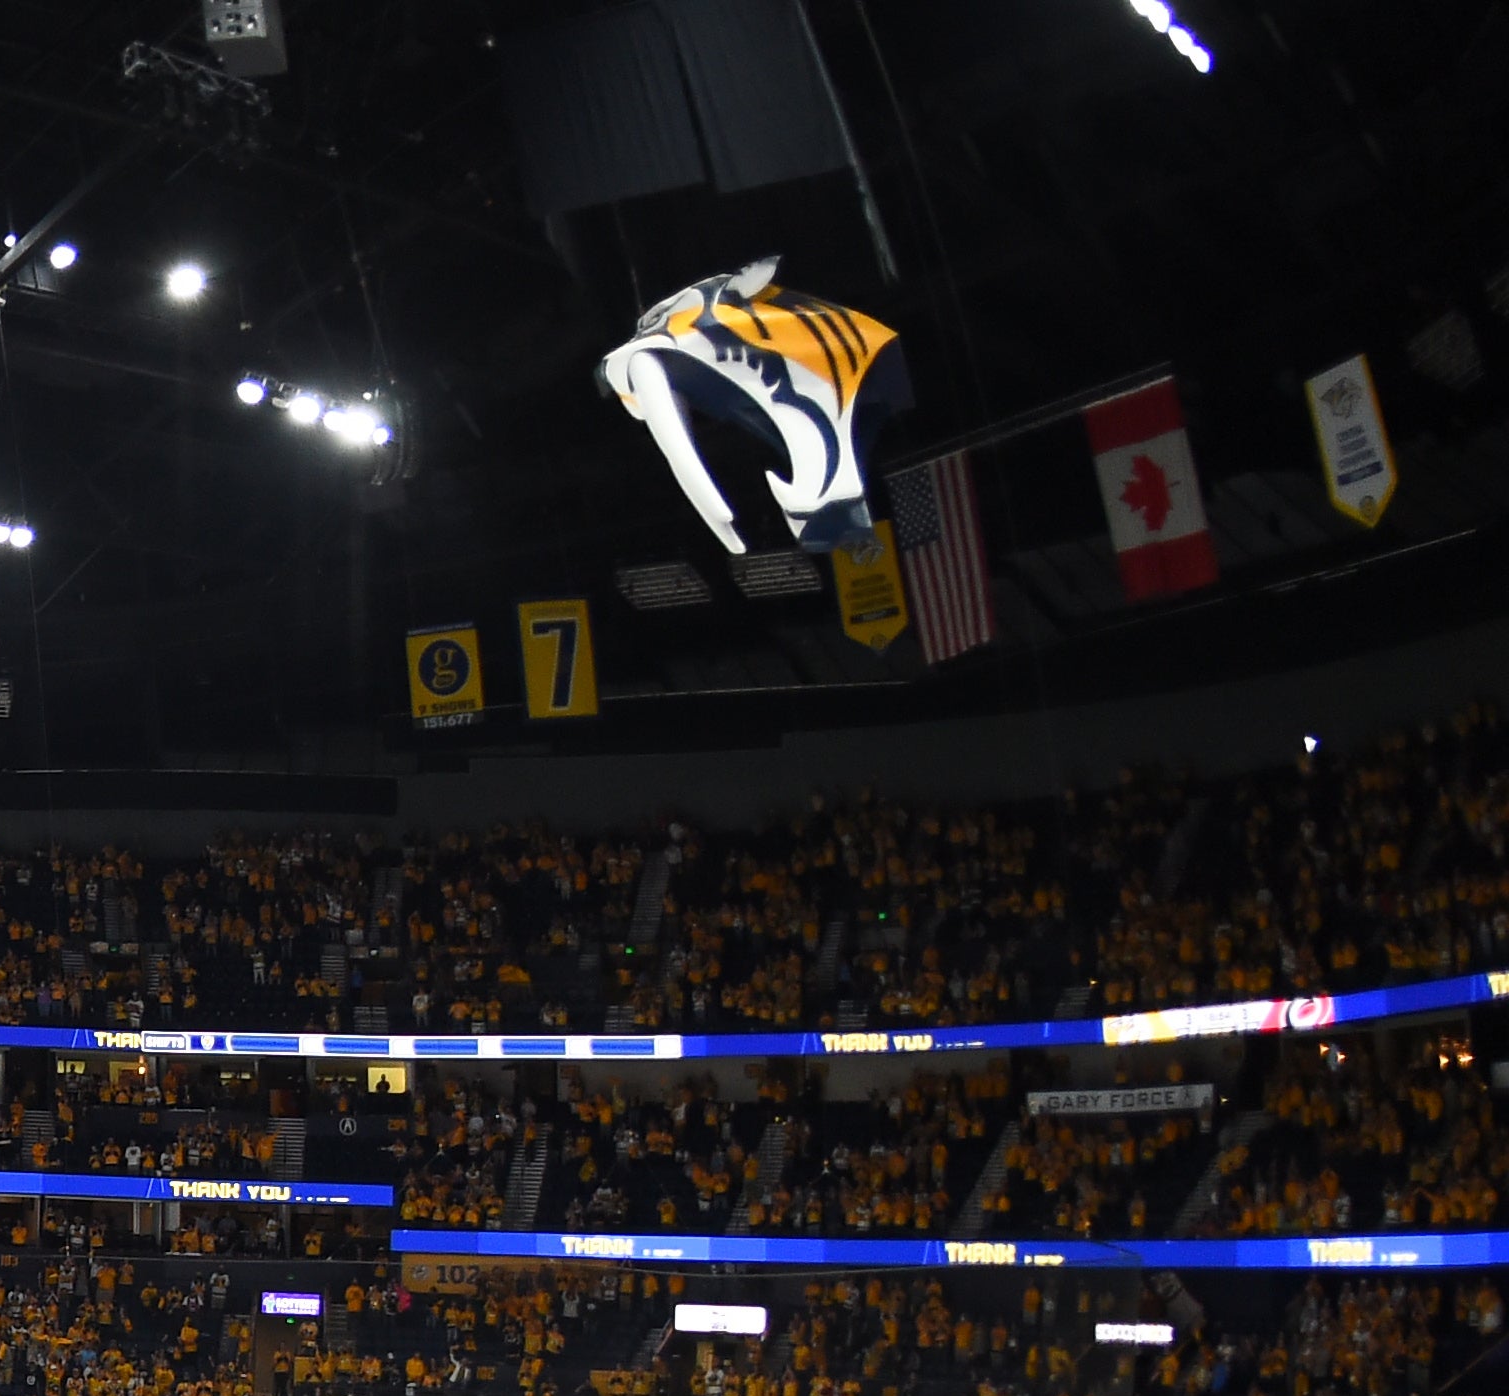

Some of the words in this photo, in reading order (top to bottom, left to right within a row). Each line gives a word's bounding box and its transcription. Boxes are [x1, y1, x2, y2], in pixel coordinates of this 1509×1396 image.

[530, 611, 580, 713] 7
[94, 1031, 141, 1049] THAN
[820, 1033, 889, 1052] THANK
[1046, 1091, 1102, 1112] GARY
[1109, 1088, 1177, 1110] FORCE
[169, 1180, 241, 1199] THANK
[247, 1184, 292, 1201] YOU
[560, 1236, 634, 1256] THANK
[944, 1242, 1016, 1265] THANK
[436, 1265, 480, 1284] 102
